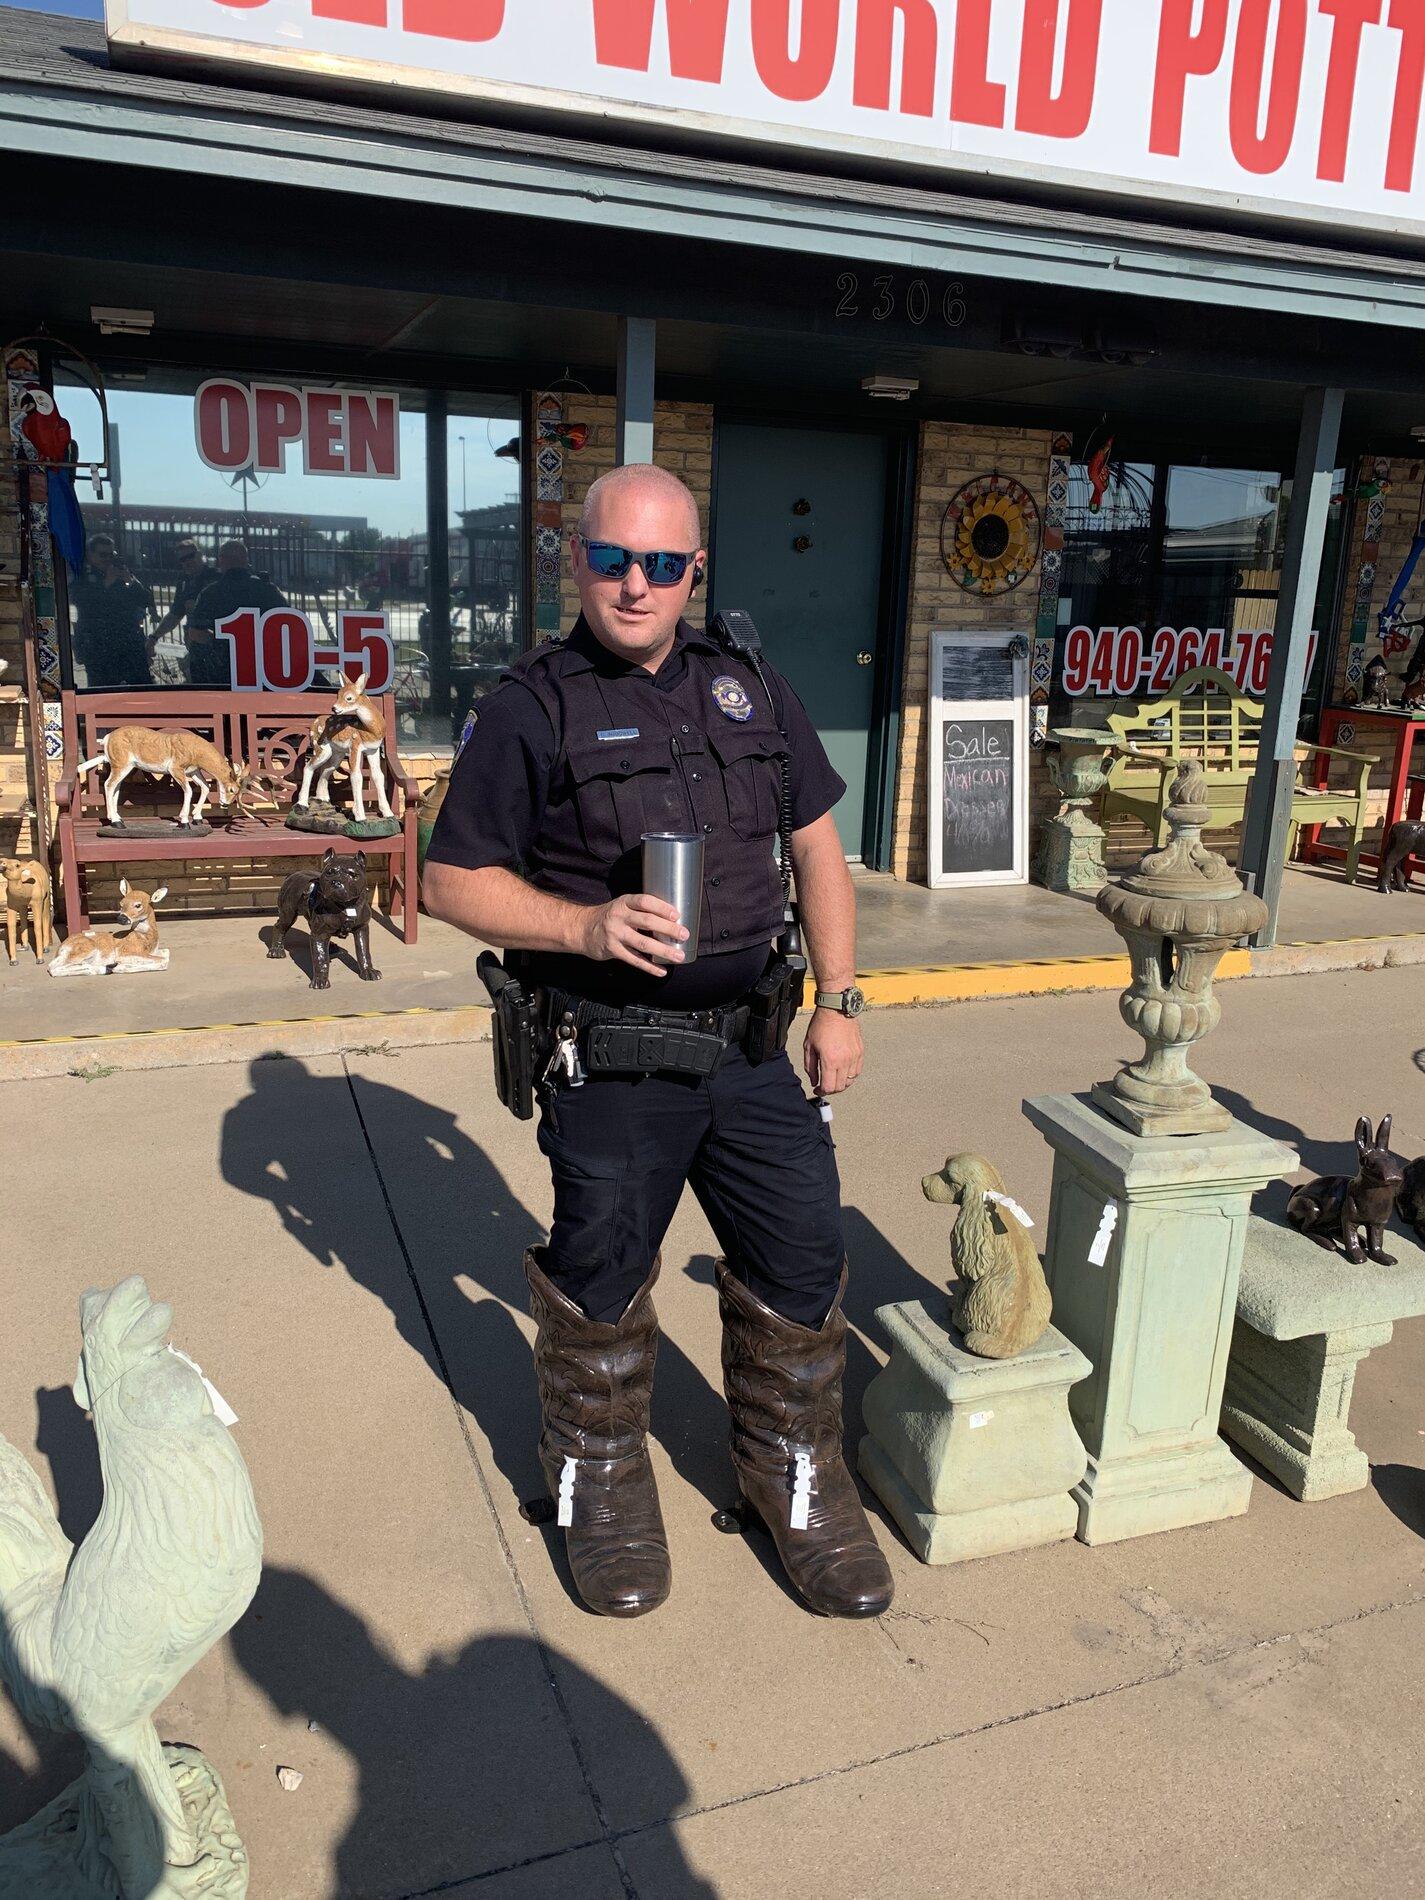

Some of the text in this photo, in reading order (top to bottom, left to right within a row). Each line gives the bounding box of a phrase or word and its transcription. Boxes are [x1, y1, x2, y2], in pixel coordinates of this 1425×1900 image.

[836, 272, 966, 327] 2306
[195, 379, 400, 479] OPEN
[215, 607, 395, 695] 10-5
[1064, 626, 1319, 695] 940-264-76
[945, 724, 1001, 759] Sale
